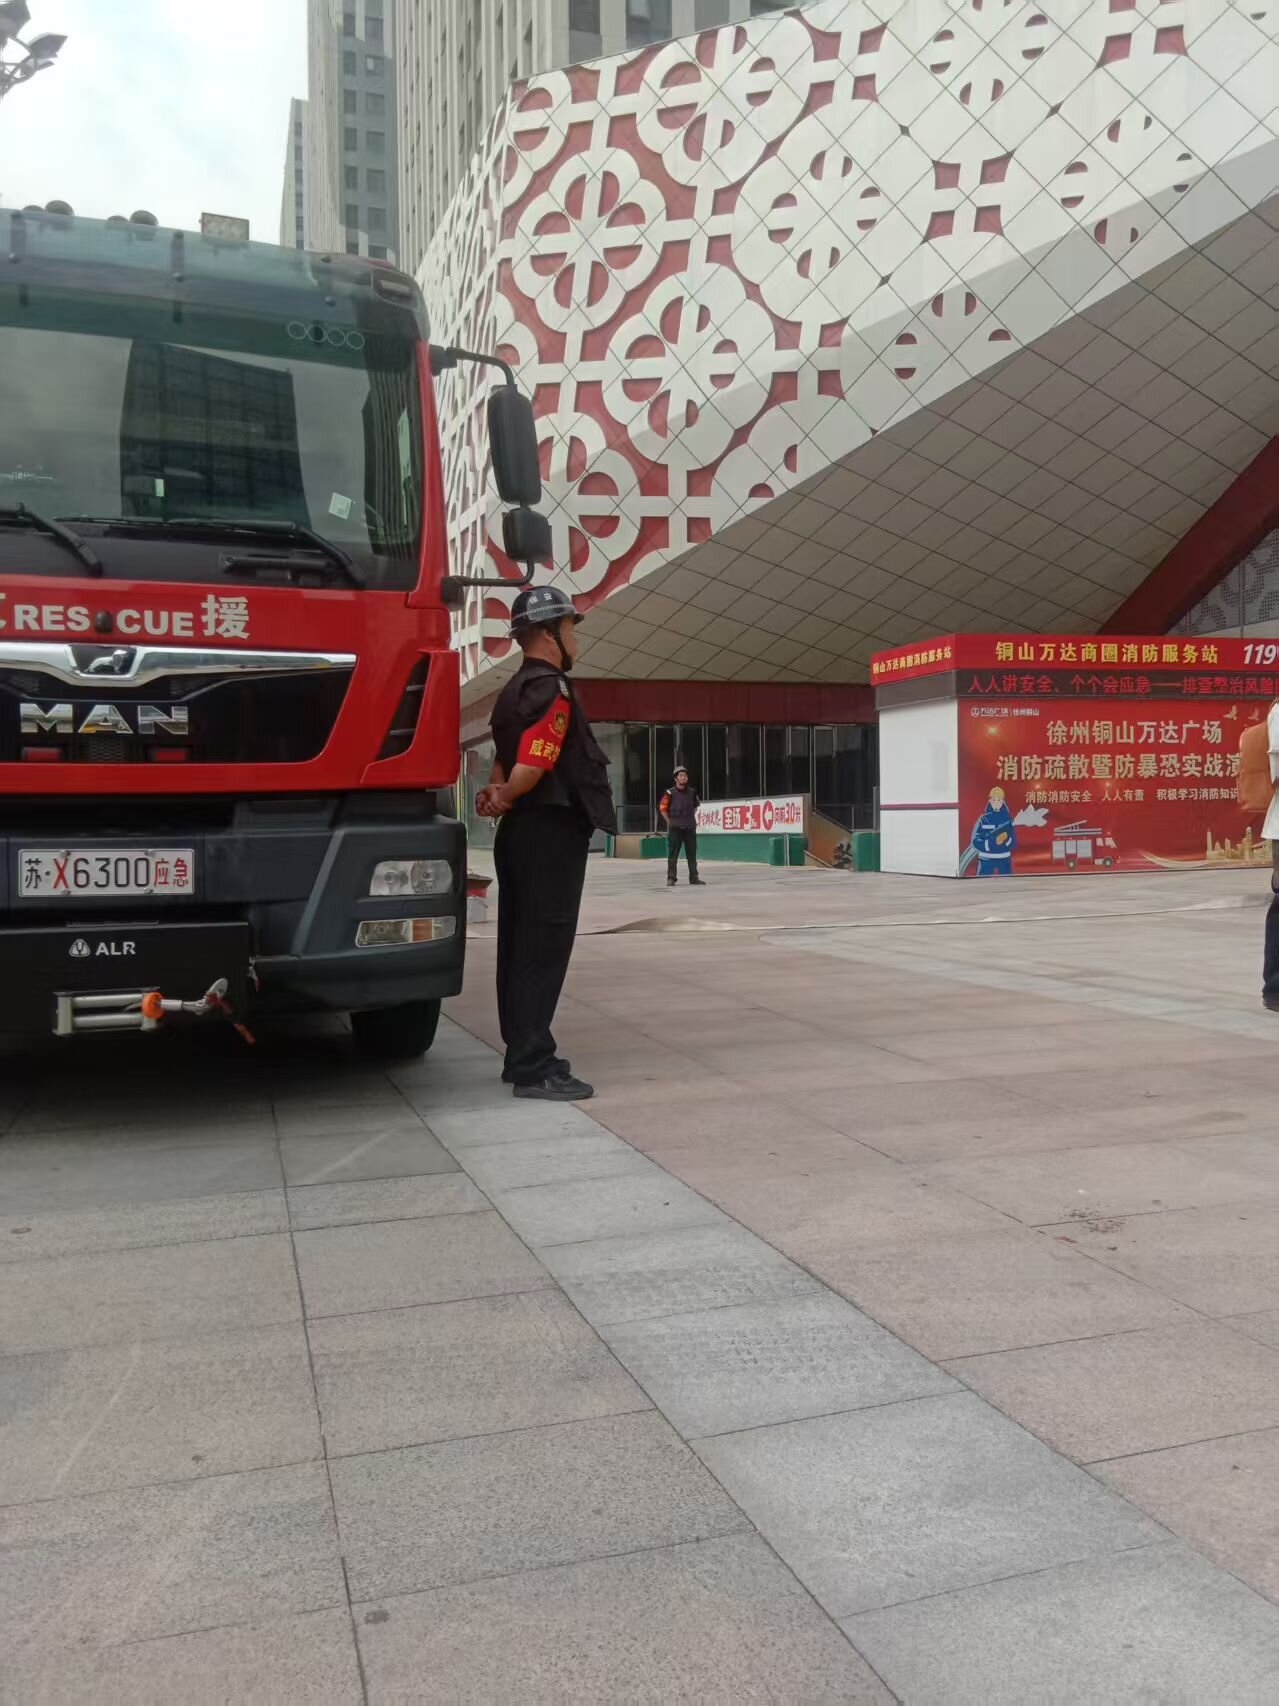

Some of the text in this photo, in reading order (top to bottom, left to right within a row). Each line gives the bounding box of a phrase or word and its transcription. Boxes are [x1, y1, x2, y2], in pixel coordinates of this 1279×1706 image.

[201, 594, 250, 639] 援
[995, 641, 1277, 665] 铜山万达商圈消防服务站 119
[19, 703, 189, 735] MAN
[1046, 720, 1222, 745] 徐州铜山万达广场
[95, 941, 136, 956] ALR
